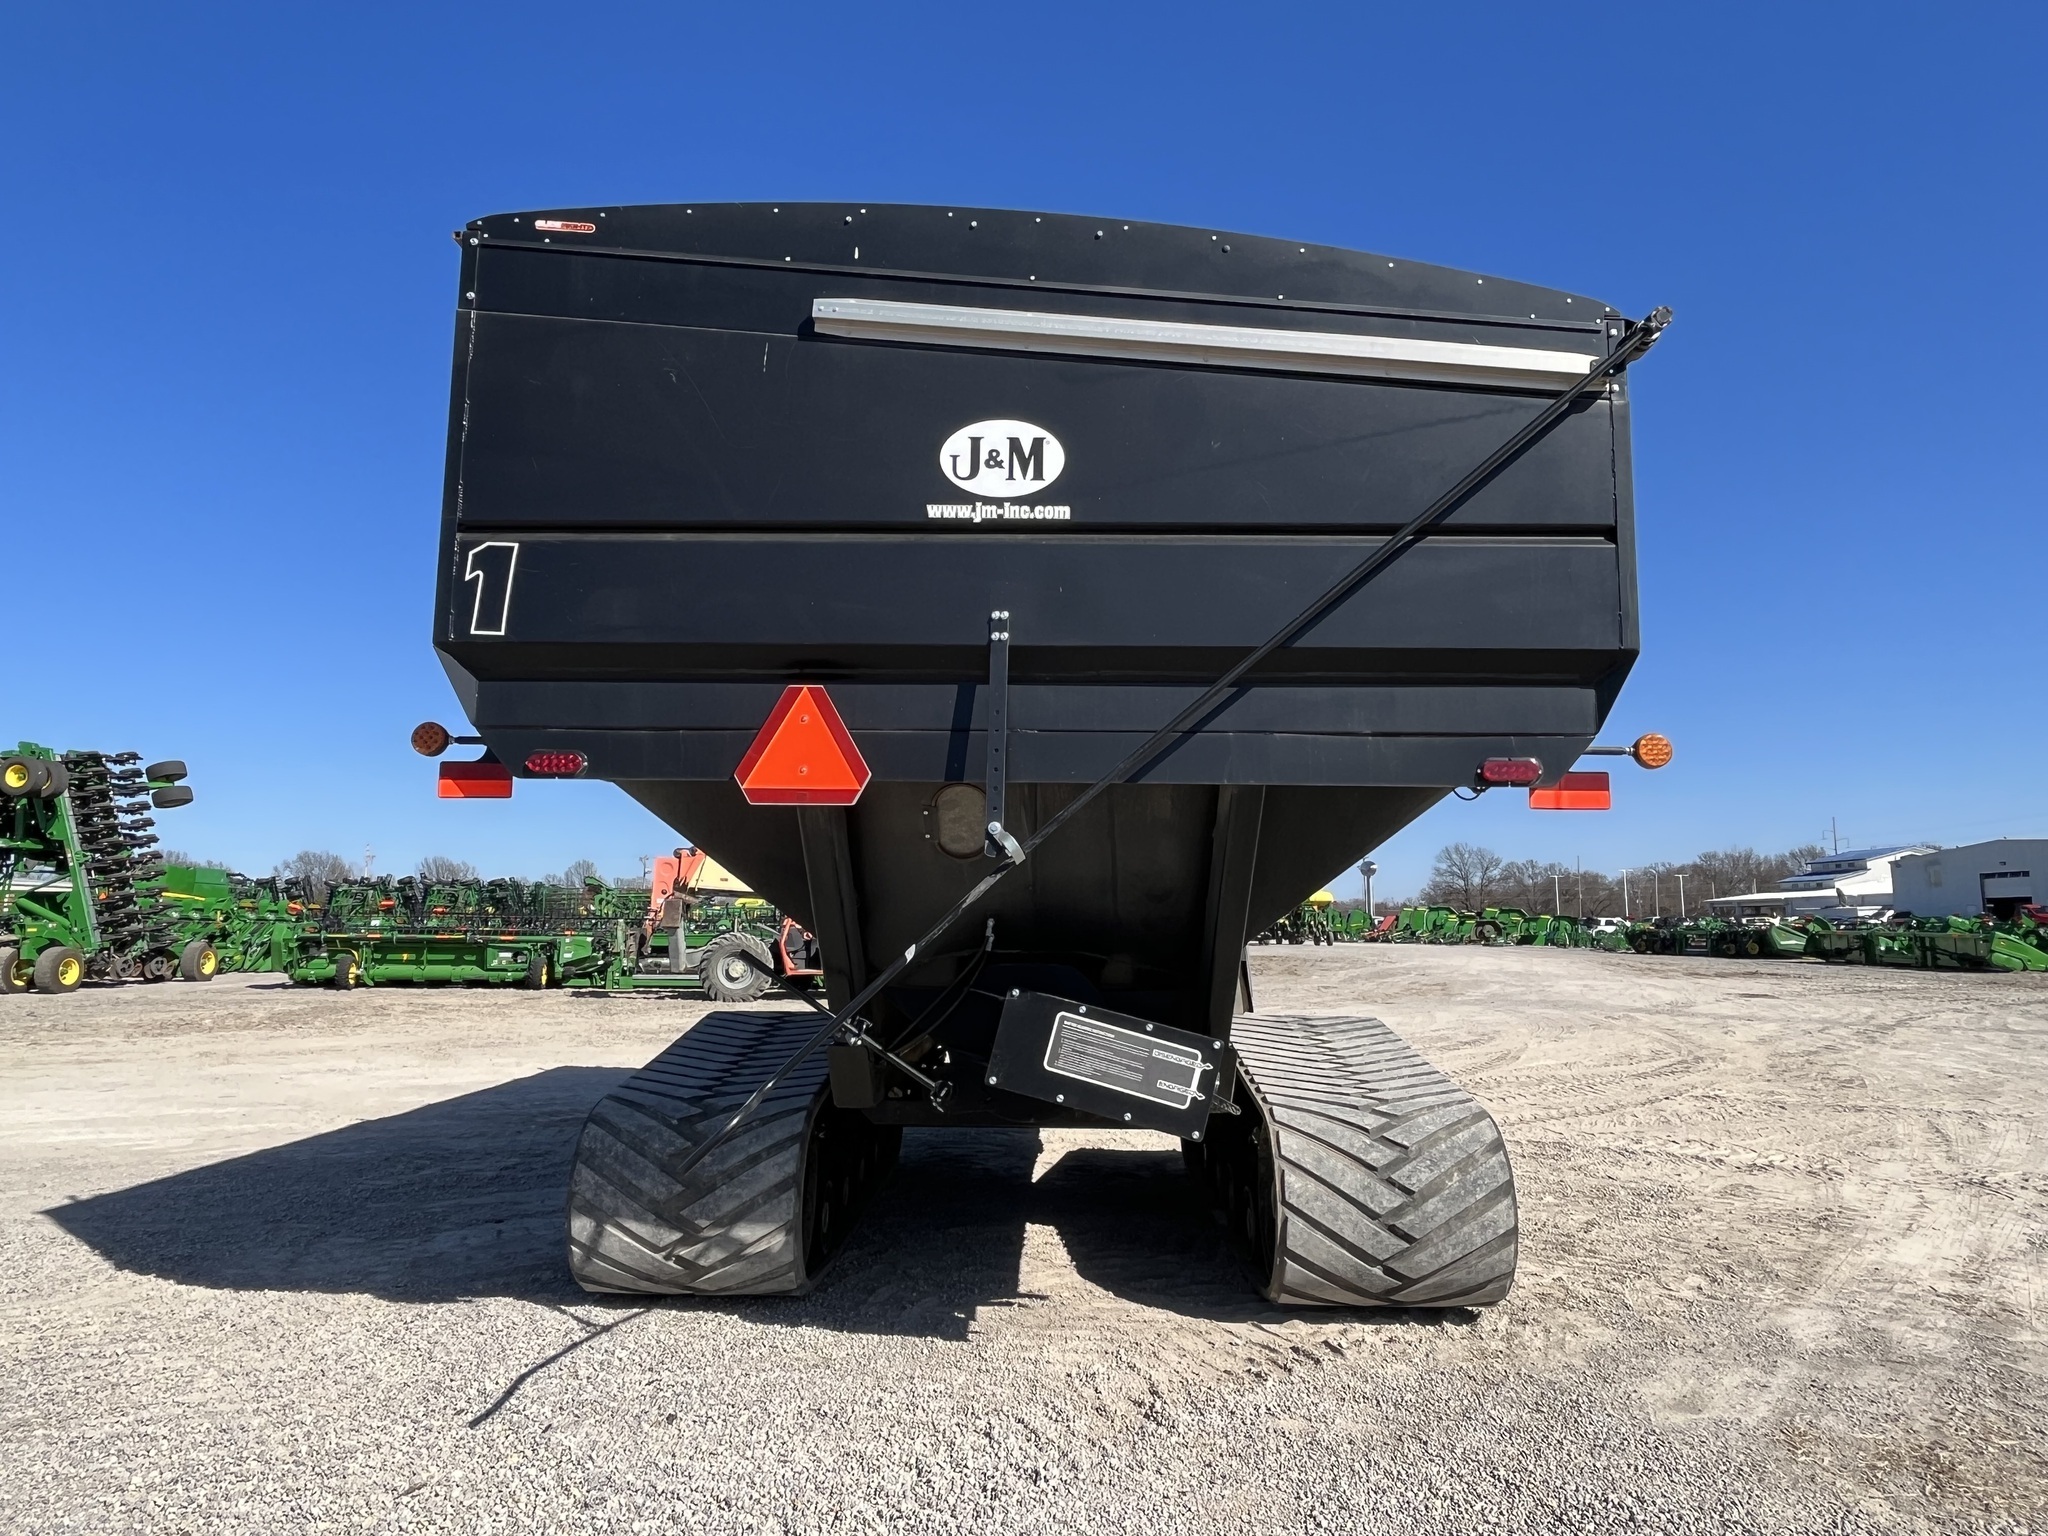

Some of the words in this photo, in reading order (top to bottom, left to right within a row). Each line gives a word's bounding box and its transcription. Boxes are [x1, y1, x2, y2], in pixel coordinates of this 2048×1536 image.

[949, 436, 1047, 482] J&M
[926, 502, 1071, 523] www.jm-inc.com
[464, 541, 519, 636] 1
